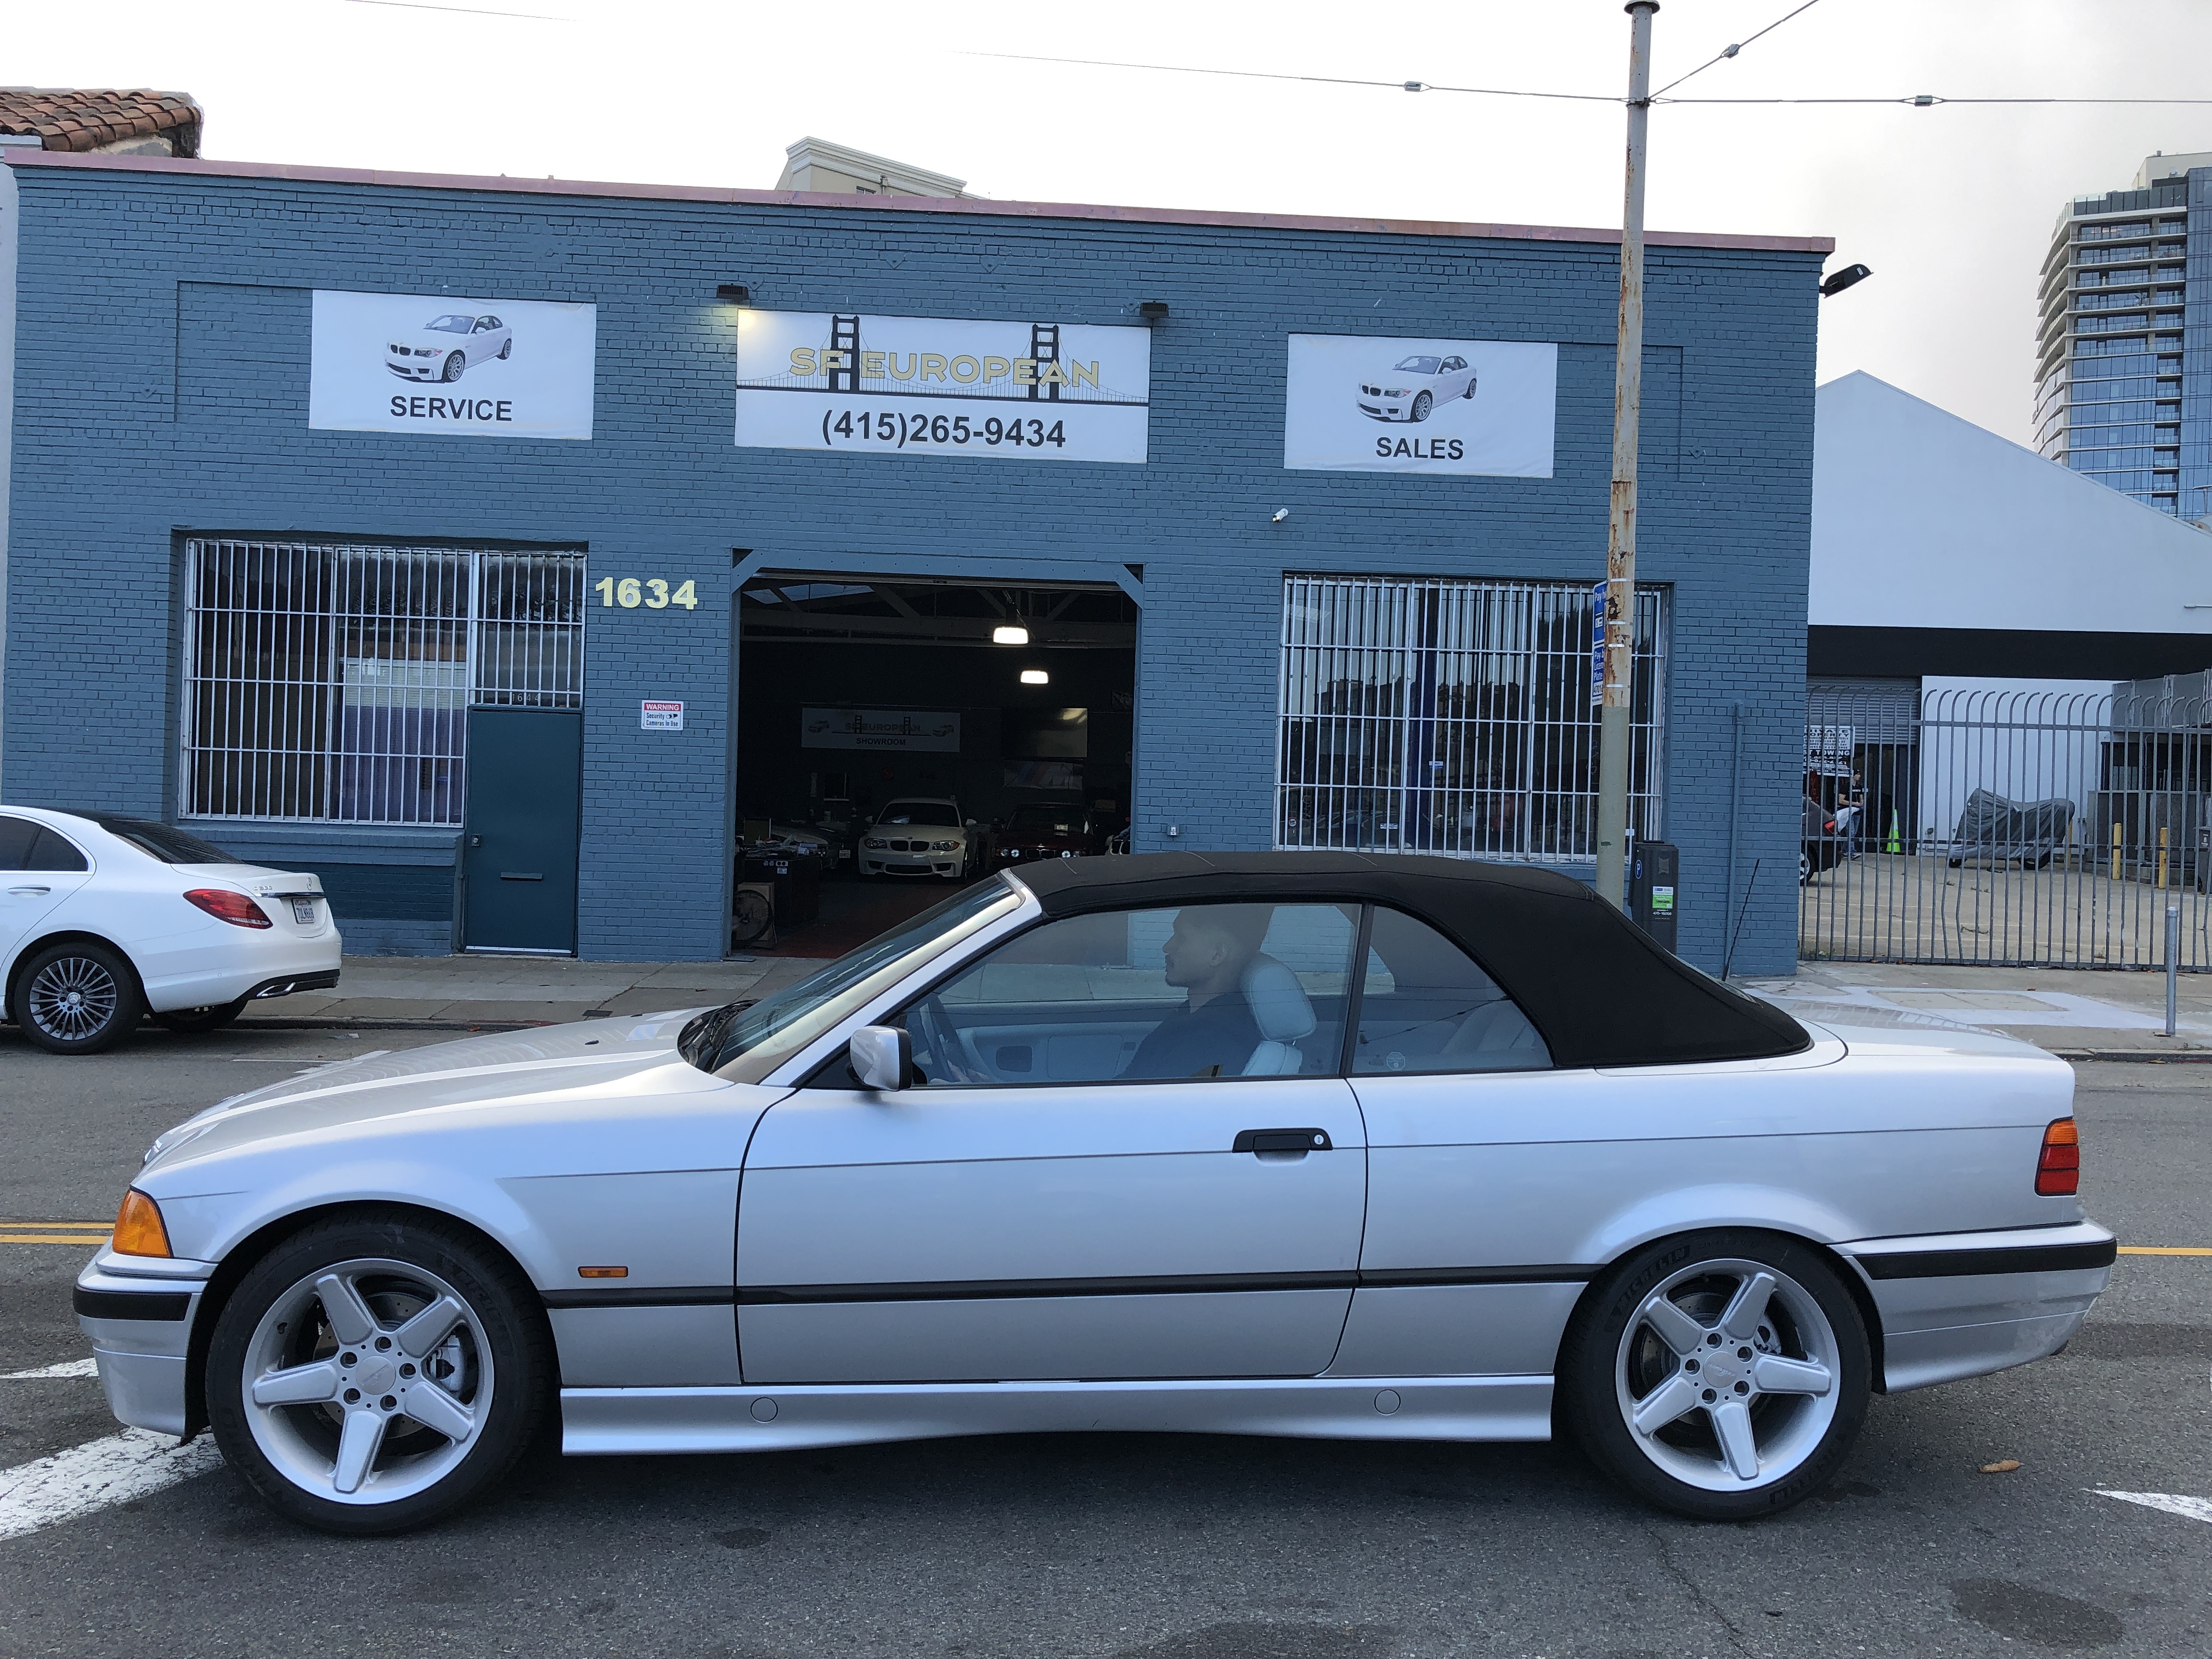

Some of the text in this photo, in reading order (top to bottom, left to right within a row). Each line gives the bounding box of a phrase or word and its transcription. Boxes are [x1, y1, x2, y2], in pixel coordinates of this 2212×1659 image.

[789, 347, 1099, 390] SF EUROPEAN
[390, 395, 512, 422] SERVICE
[822, 409, 1066, 448] (415)265-9434
[1376, 437, 1464, 460] SALES
[595, 577, 698, 610] 1634
[1594, 662, 1604, 670] Licen
[1594, 672, 1602, 681] Plate
[856, 737, 906, 746] SHOWROOM
